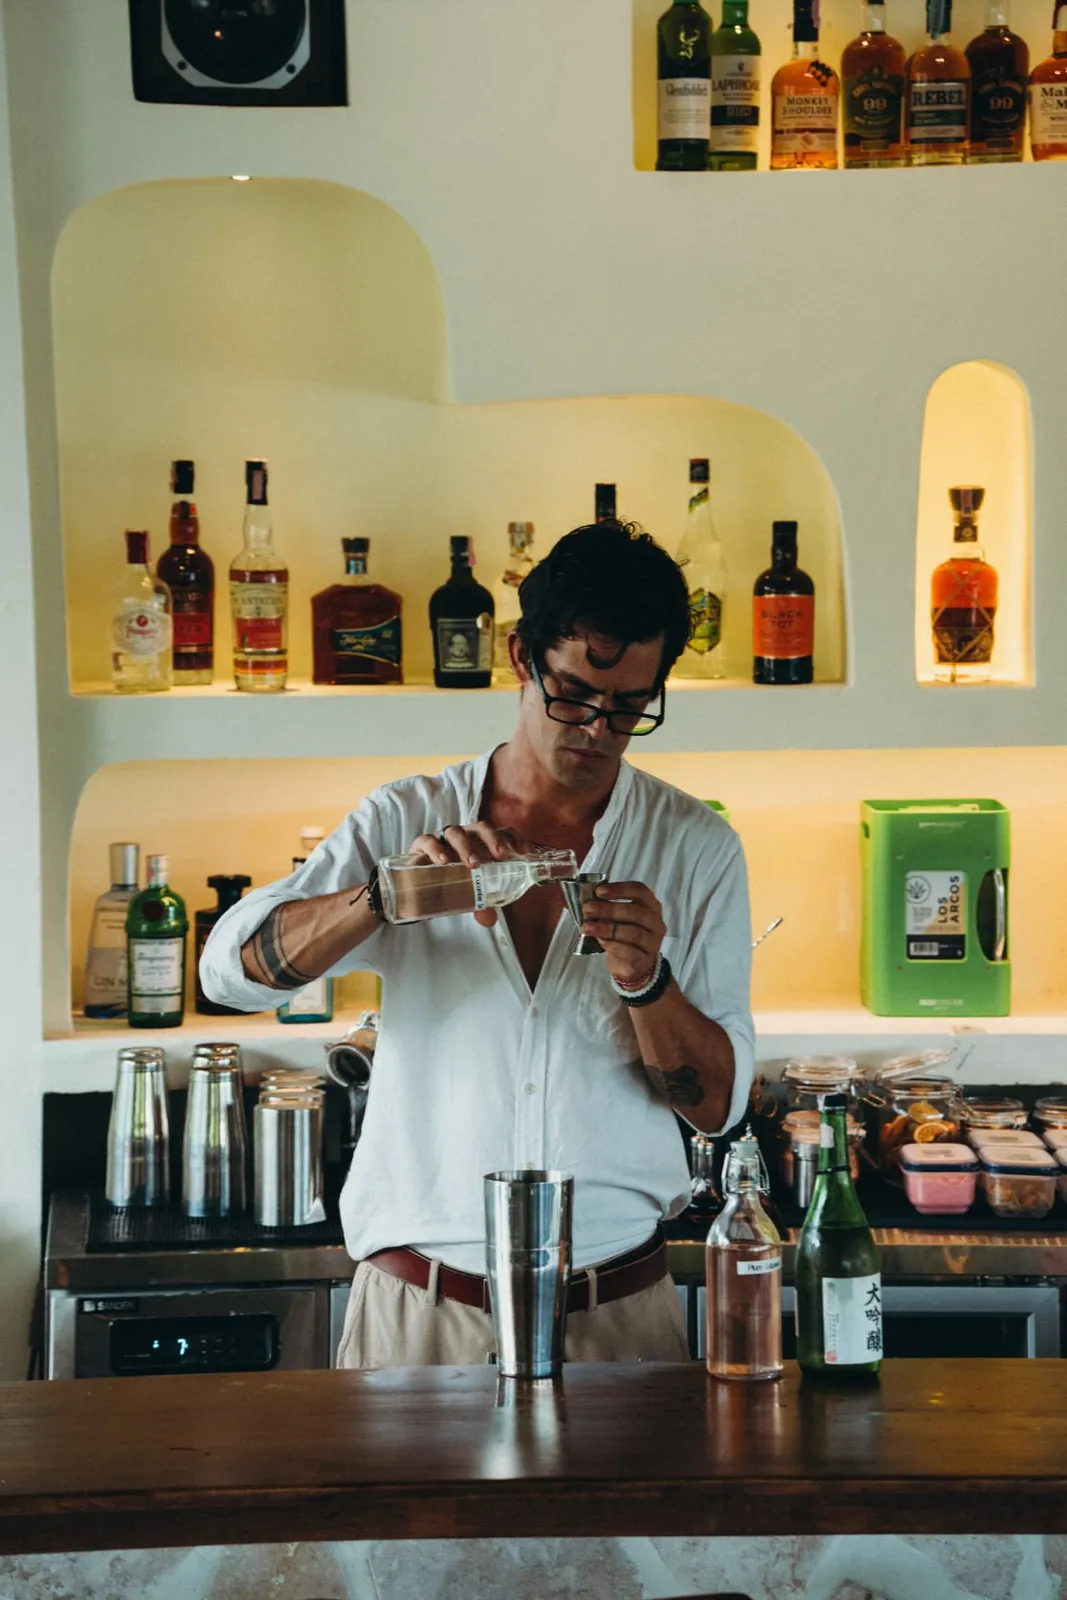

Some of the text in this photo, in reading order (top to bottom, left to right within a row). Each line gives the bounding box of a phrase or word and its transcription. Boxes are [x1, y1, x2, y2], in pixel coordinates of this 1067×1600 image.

[786, 96, 829, 105] MONKEY
[912, 90, 962, 106] REBEL
[782, 106, 832, 115] SHOULDER
[761, 609, 804, 619] BLACK
[949, 875, 961, 924] ARCOS
[938, 897, 949, 924] LOS
